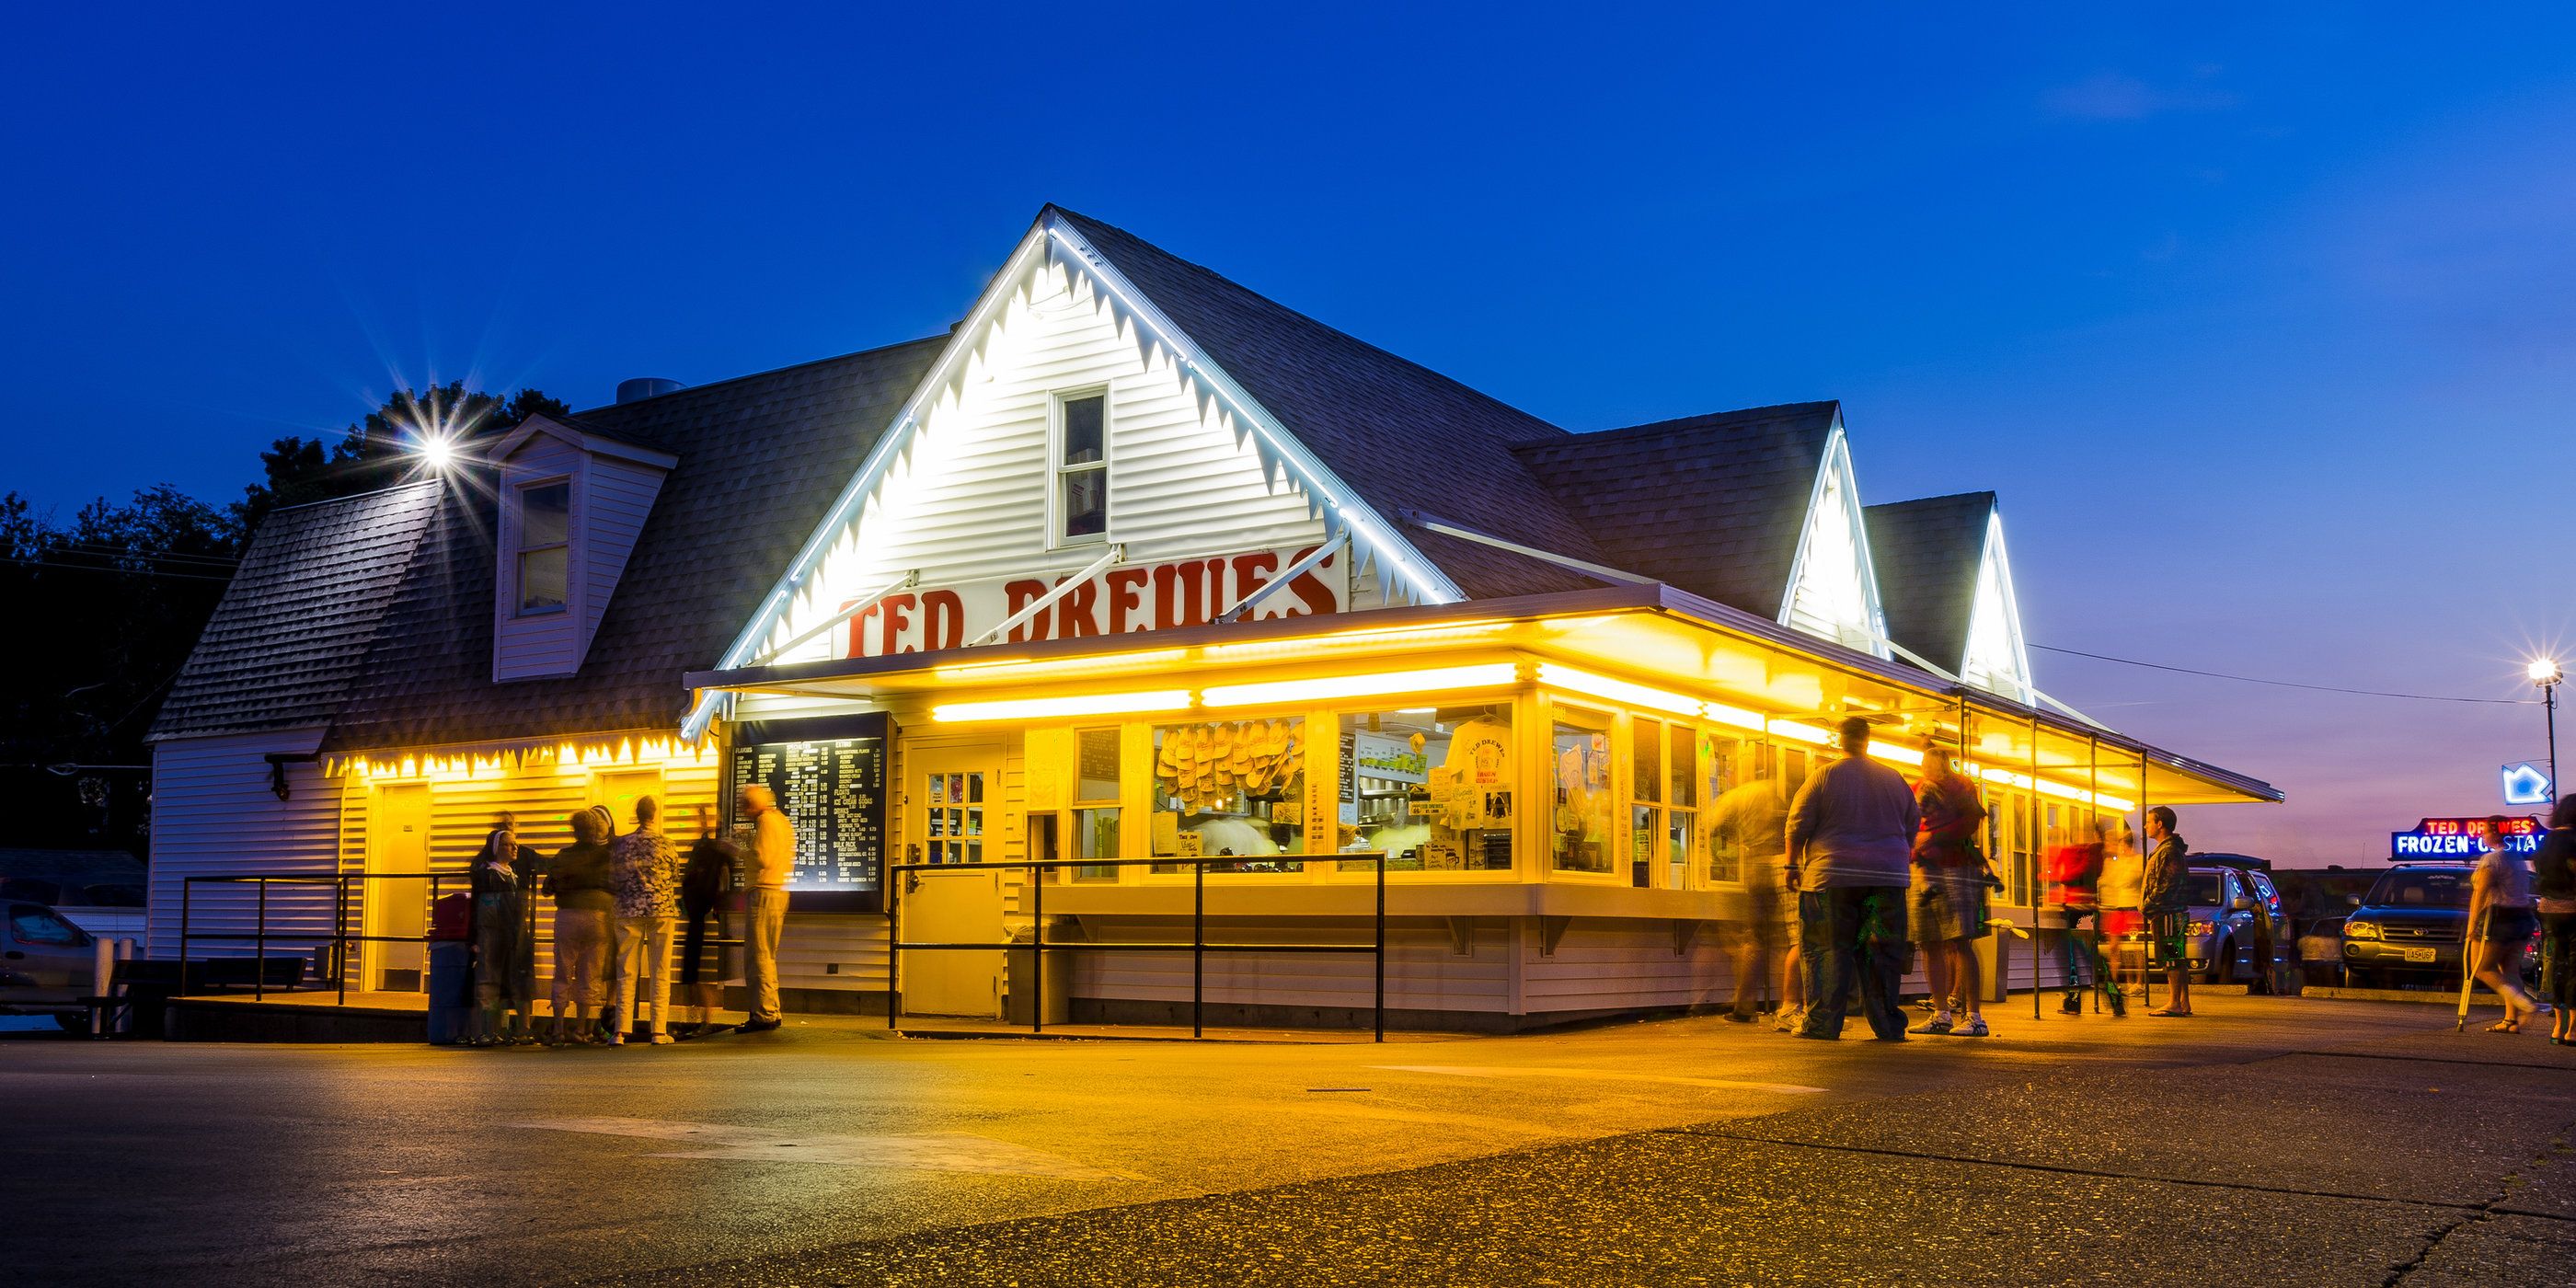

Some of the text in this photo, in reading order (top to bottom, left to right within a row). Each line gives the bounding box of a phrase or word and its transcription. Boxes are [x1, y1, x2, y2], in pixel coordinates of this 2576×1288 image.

[838, 545, 1337, 659] TED DREWES
[2427, 820, 2532, 836] TED DRWES
[2397, 835, 2469, 854] FROZEN
